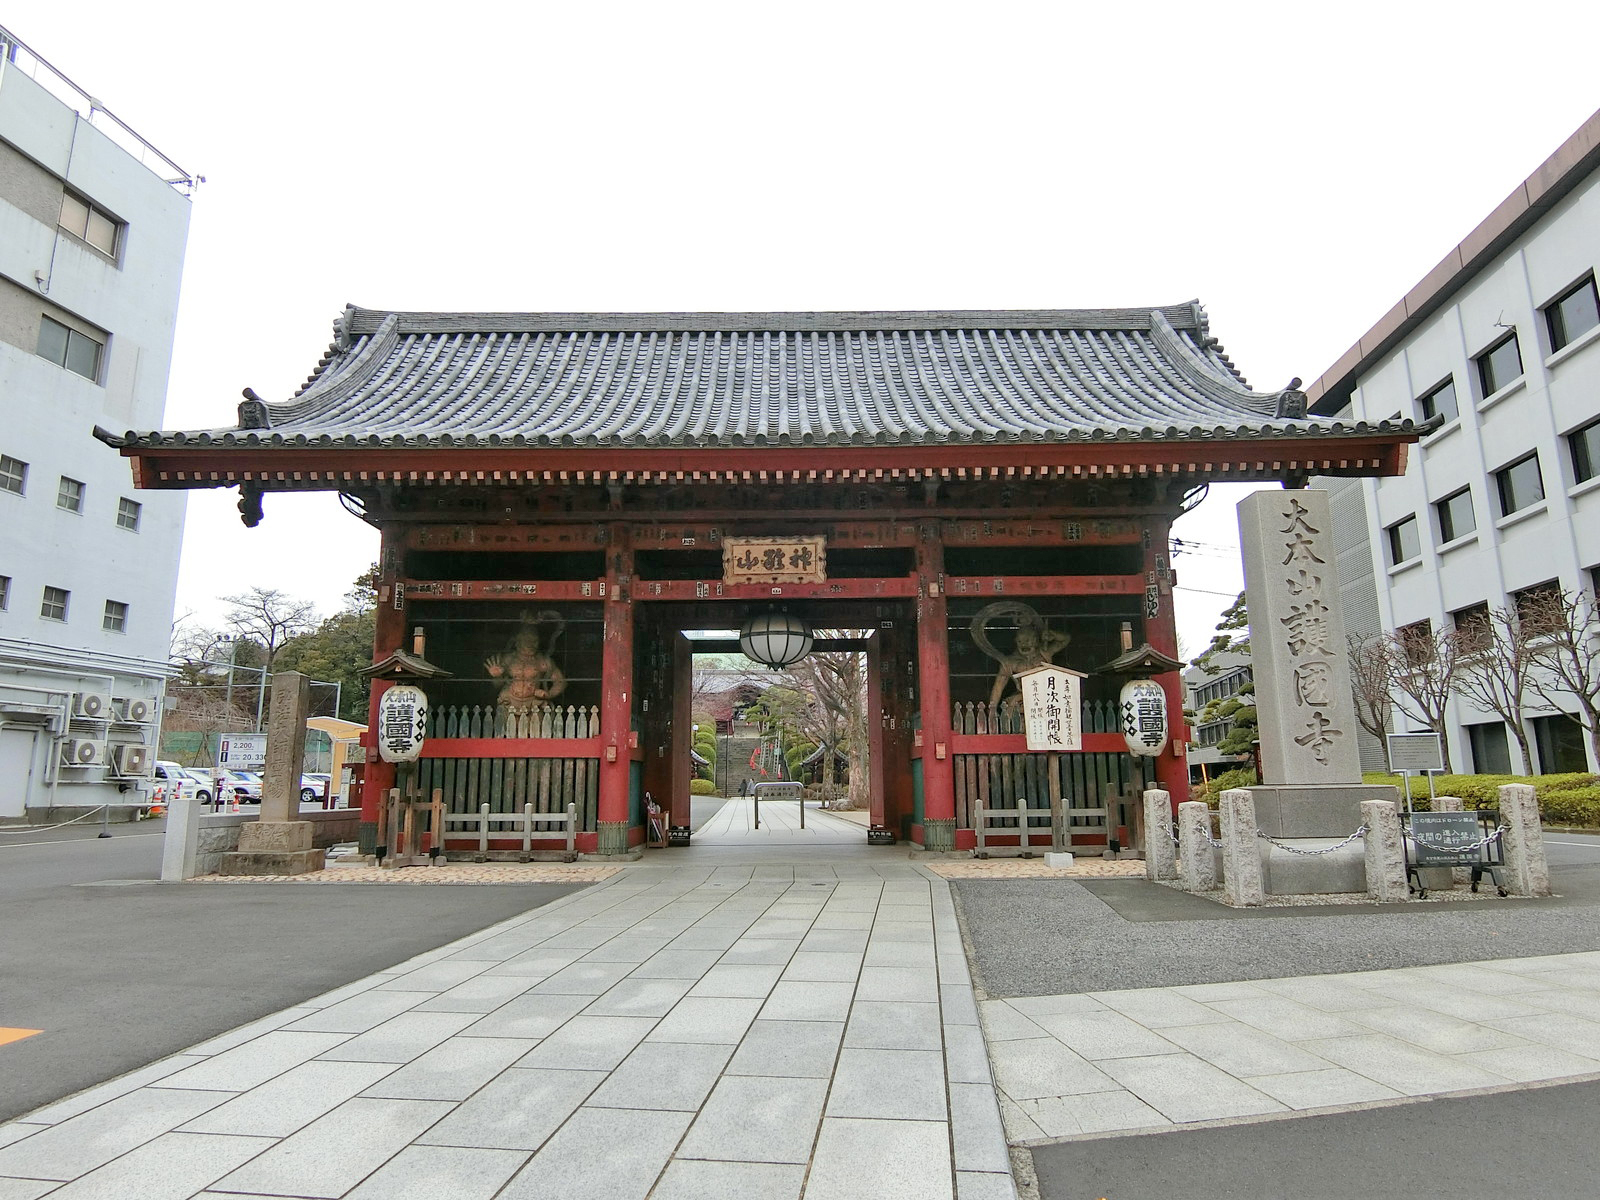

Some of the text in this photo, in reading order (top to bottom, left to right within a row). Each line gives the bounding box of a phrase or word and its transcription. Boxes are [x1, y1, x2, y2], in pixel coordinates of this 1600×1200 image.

[385, 690, 416, 703] 大本山
[1045, 676, 1063, 745] 月次御開帳
[1133, 683, 1162, 697] 大本山
[386, 703, 414, 753] 護國寺
[1136, 697, 1164, 747] 護國寺
